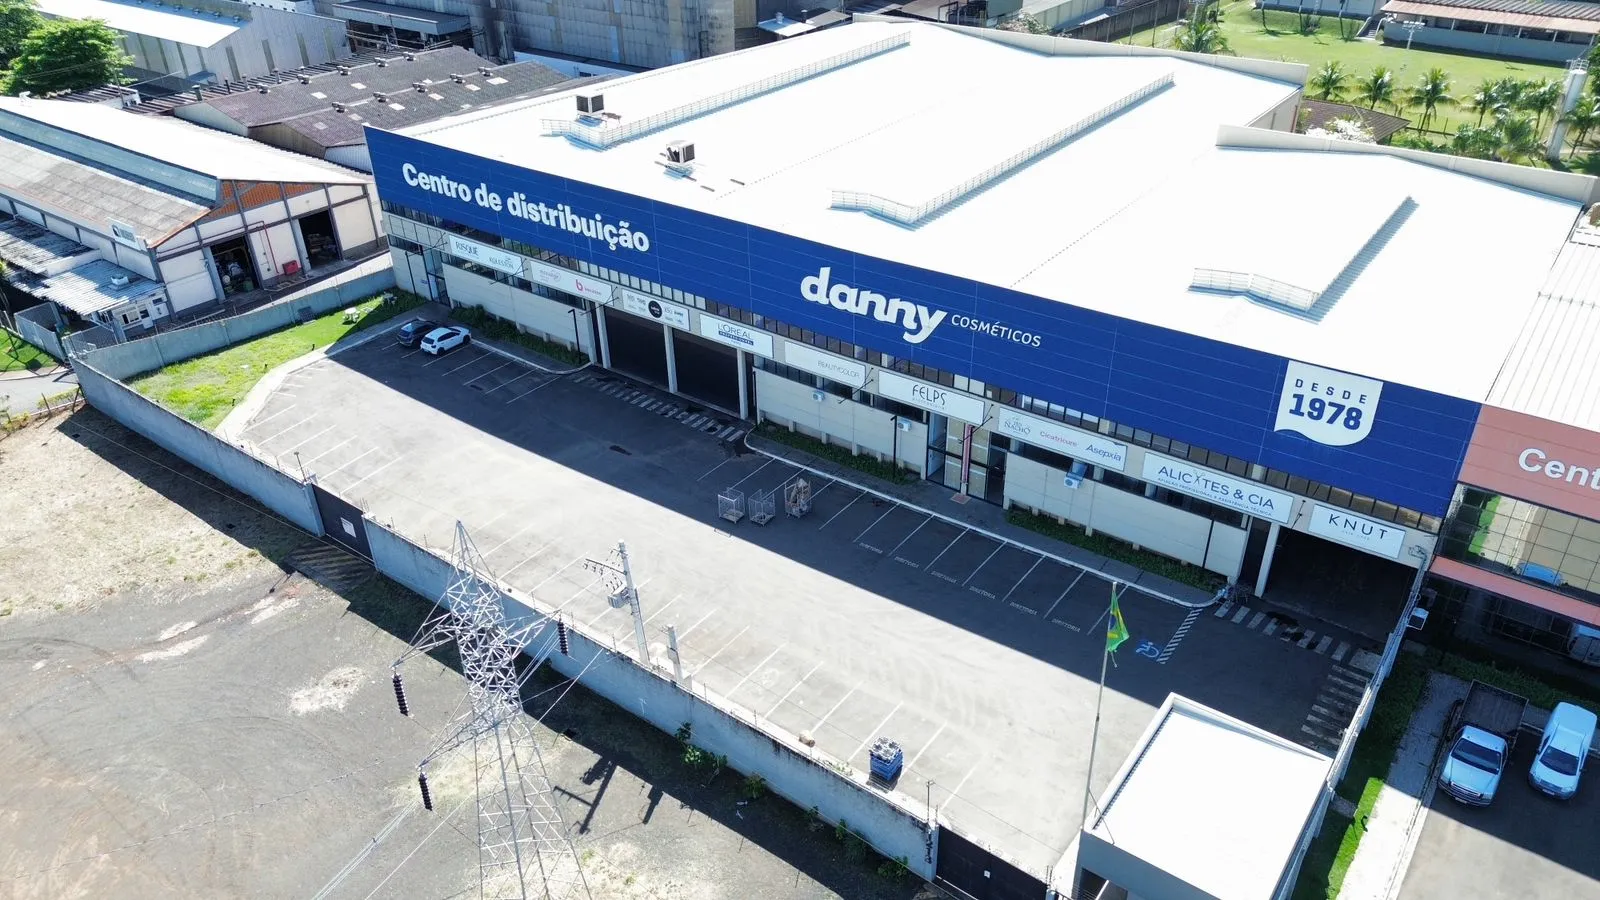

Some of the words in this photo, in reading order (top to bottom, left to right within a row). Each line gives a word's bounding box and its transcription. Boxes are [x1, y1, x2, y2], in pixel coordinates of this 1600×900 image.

[402, 163, 472, 202] Centro
[475, 183, 502, 212] de
[507, 192, 650, 252] distribuição
[800, 267, 948, 343] danny
[951, 314, 1042, 347] COSMÉTICOS
[912, 384, 948, 406] FELPS
[1295, 378, 1368, 404] DESDE
[1289, 393, 1363, 431] 1978
[1086, 444, 1122, 462] Asepxia
[1233, 488, 1244, 501] &
[1248, 493, 1275, 510] CIA
[1328, 513, 1388, 540] KNUT
